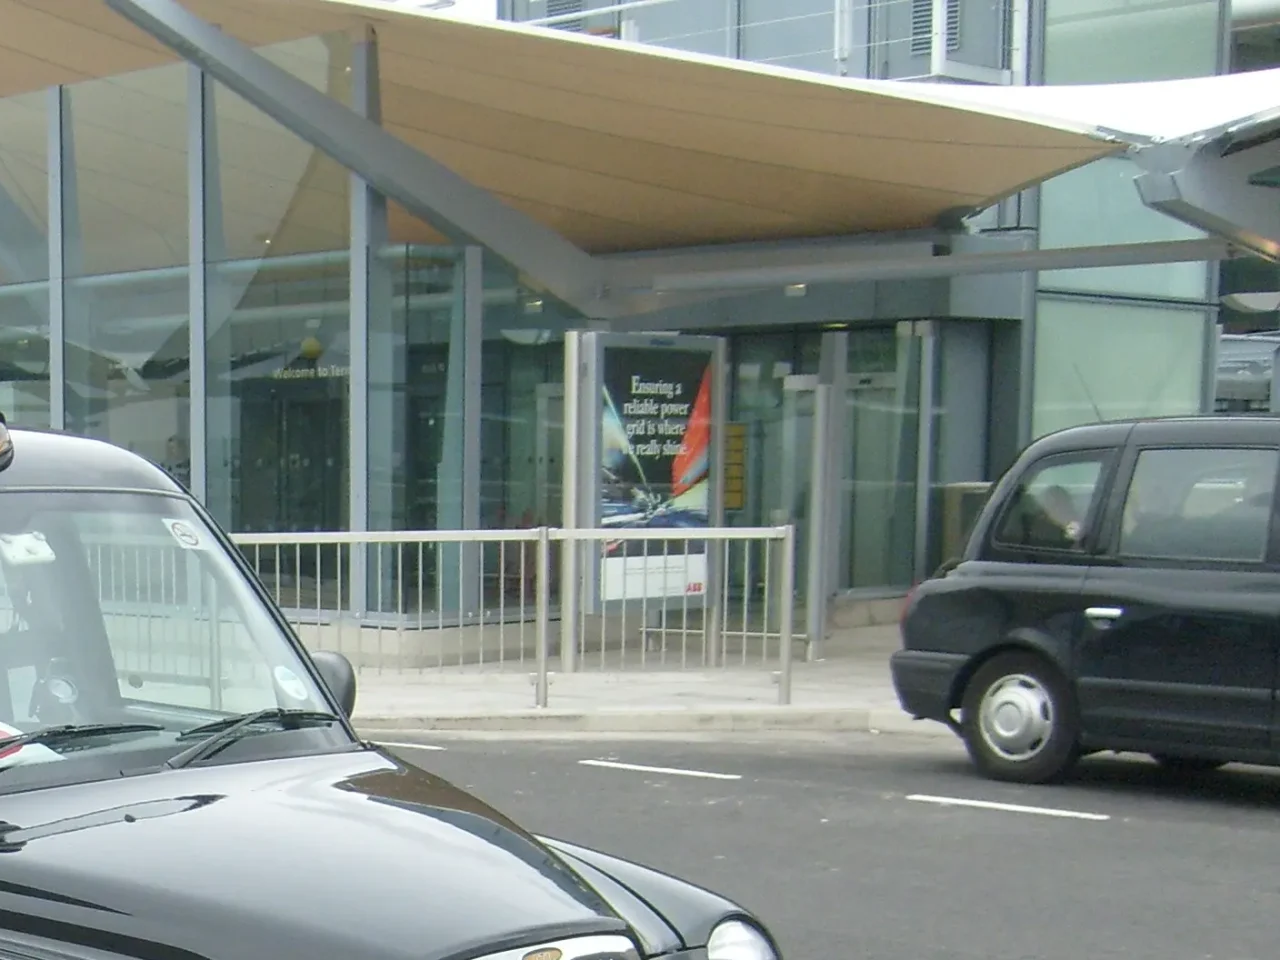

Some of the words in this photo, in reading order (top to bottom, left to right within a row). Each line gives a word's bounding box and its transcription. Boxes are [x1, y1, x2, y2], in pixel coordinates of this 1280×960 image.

[318, 365, 329, 378] to
[631, 375, 674, 399] Ensuring
[675, 382, 682, 395] a
[623, 398, 659, 415] reliable
[660, 403, 690, 419] power
[626, 419, 646, 439] grid
[647, 420, 656, 435] is
[657, 419, 686, 436] where
[636, 439, 661, 460] really
[662, 439, 688, 455] shine
[685, 582, 703, 593] ABB
